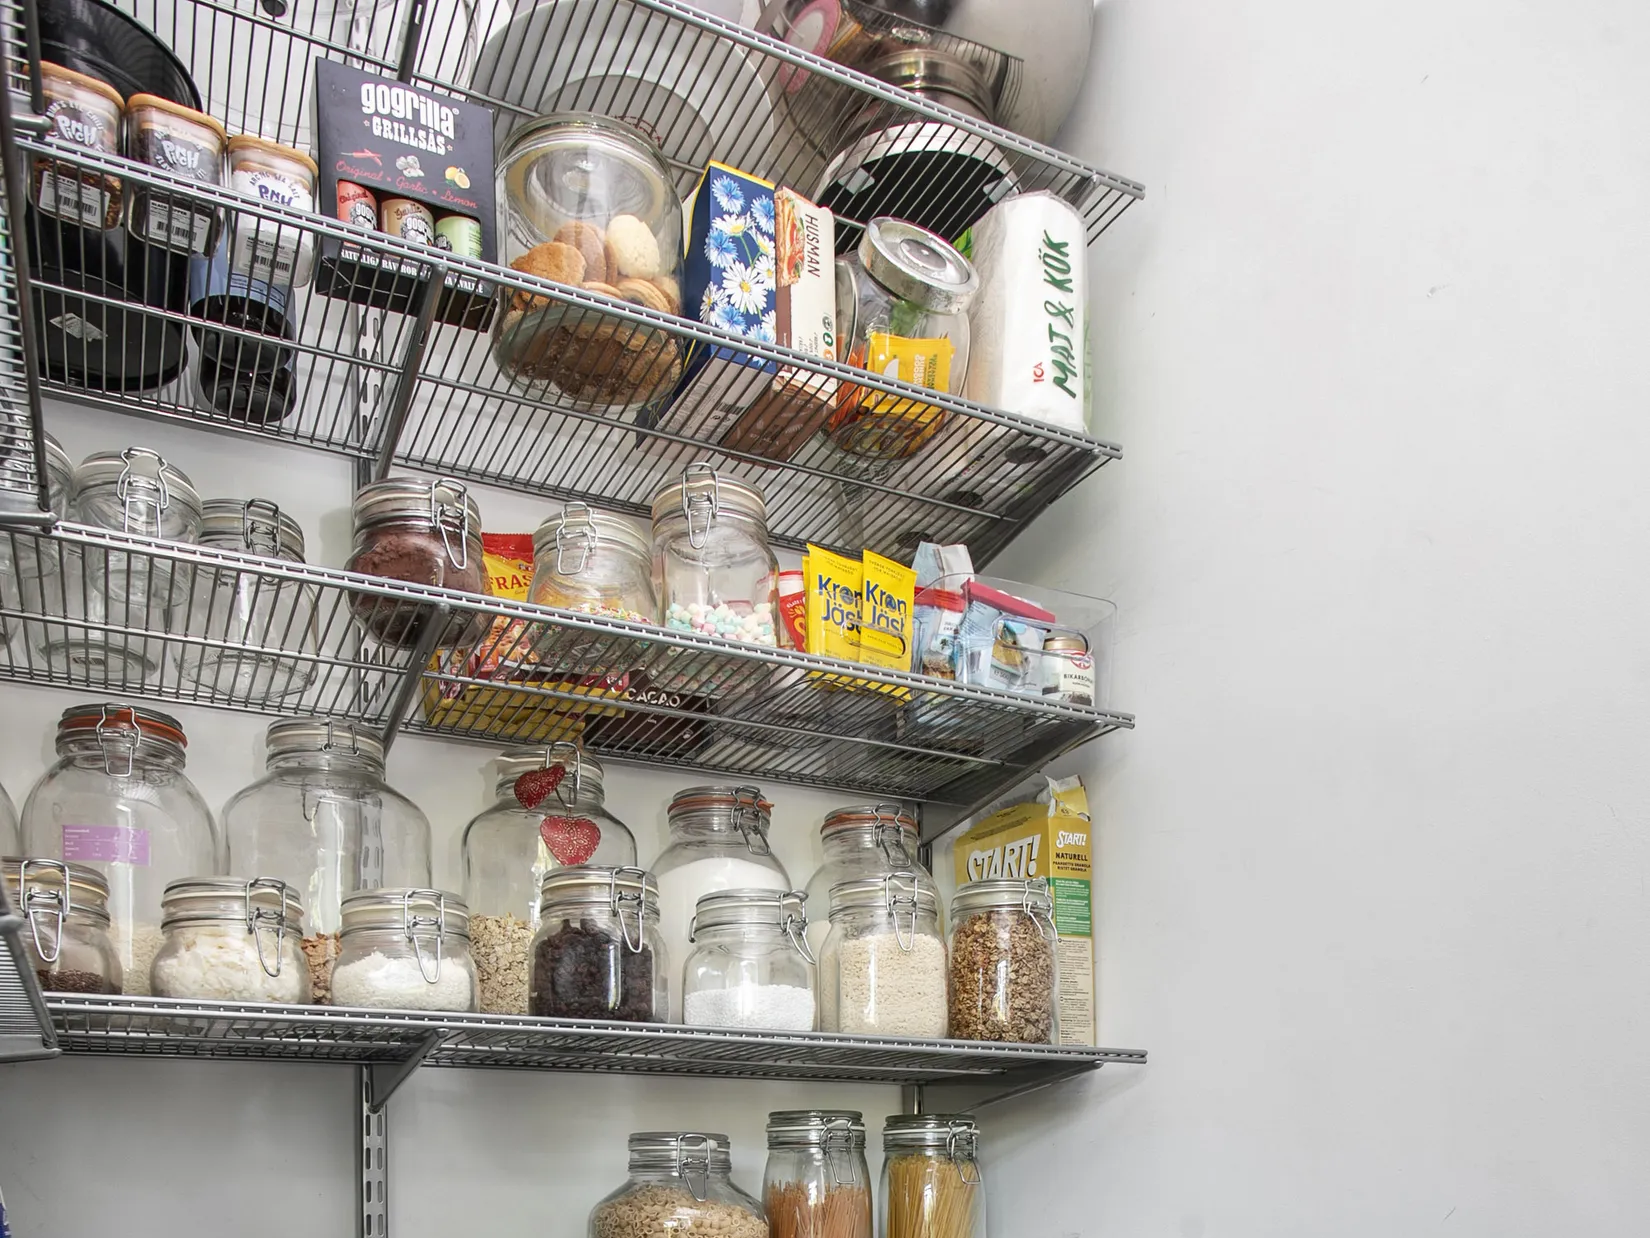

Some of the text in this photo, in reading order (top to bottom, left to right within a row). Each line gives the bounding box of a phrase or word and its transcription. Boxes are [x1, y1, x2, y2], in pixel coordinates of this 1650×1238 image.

[372, 115, 446, 156] GRILLSÅS
[335, 160, 384, 182] Original
[440, 190, 478, 209] Lemon
[805, 213, 821, 278] HUSMAN
[1038, 229, 1078, 400] MAT & KÖK
[1033, 361, 1045, 383] ICA
[627, 688, 681, 708] CACAO
[967, 834, 1041, 882] START!
[1055, 852, 1089, 861] NATURELL
[1056, 830, 1087, 848] START!
